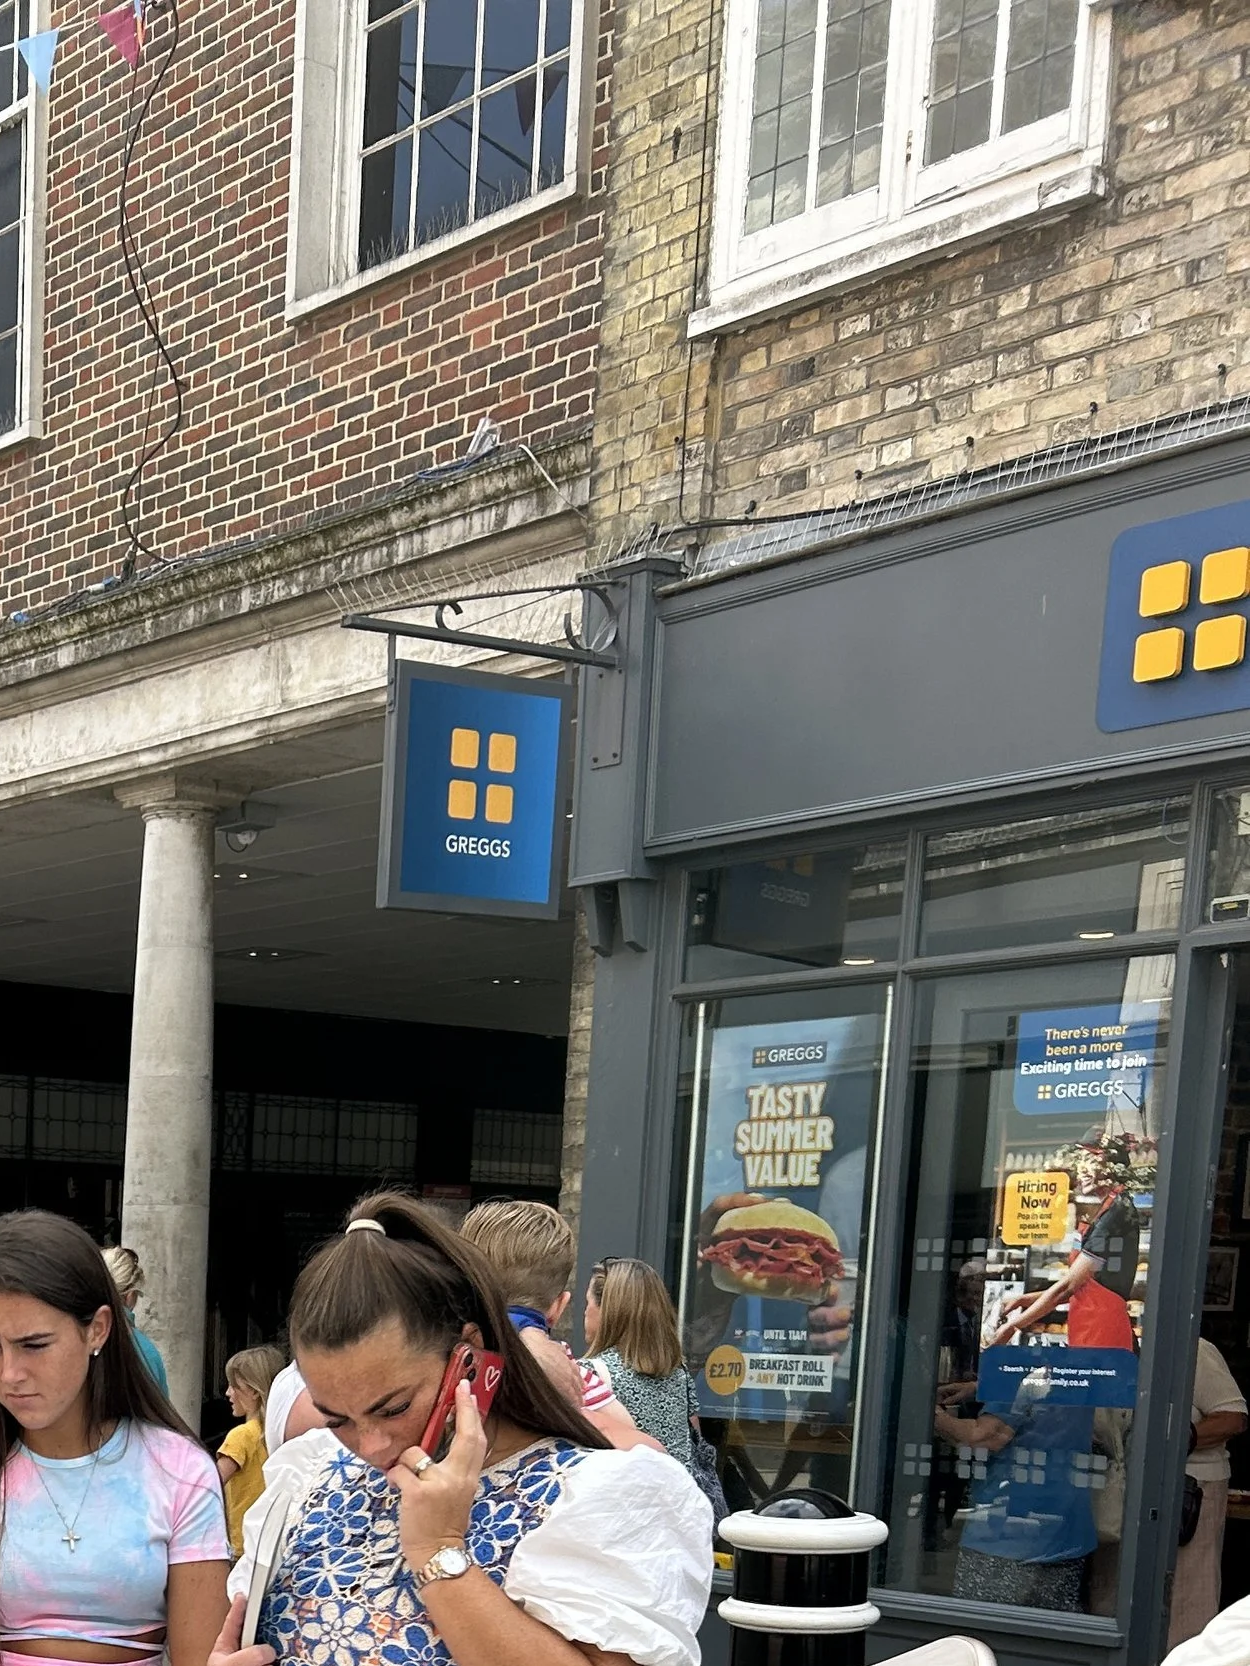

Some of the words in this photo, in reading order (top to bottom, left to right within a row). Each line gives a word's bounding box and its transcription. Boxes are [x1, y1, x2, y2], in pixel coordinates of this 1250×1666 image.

[445, 834, 511, 858] GREGGS
[1045, 1026, 1089, 1040] There's
[1092, 1024, 1129, 1037] never
[768, 1045, 823, 1063] GREGGS
[1046, 1045, 1076, 1056] been
[1079, 1046, 1087, 1054] a
[1090, 1041, 1123, 1053] more
[1020, 1060, 1071, 1075] Exciting
[1074, 1058, 1103, 1071] time
[1106, 1056, 1119, 1069] to
[1120, 1054, 1148, 1071] join
[1054, 1080, 1124, 1099] GREGGS
[747, 1081, 827, 1118] TASTY
[735, 1116, 834, 1154] SUMMER
[744, 1152, 822, 1186] VALUE
[1017, 1179, 1057, 1196] Hiring
[1021, 1196, 1051, 1209] Now
[763, 1330, 786, 1340] UNTIL
[710, 1362, 742, 1379] £2.70
[749, 1359, 800, 1372] BREAKFAST
[802, 1360, 825, 1373] ROLL
[756, 1373, 774, 1384] ANY
[777, 1374, 795, 1385] HOT
